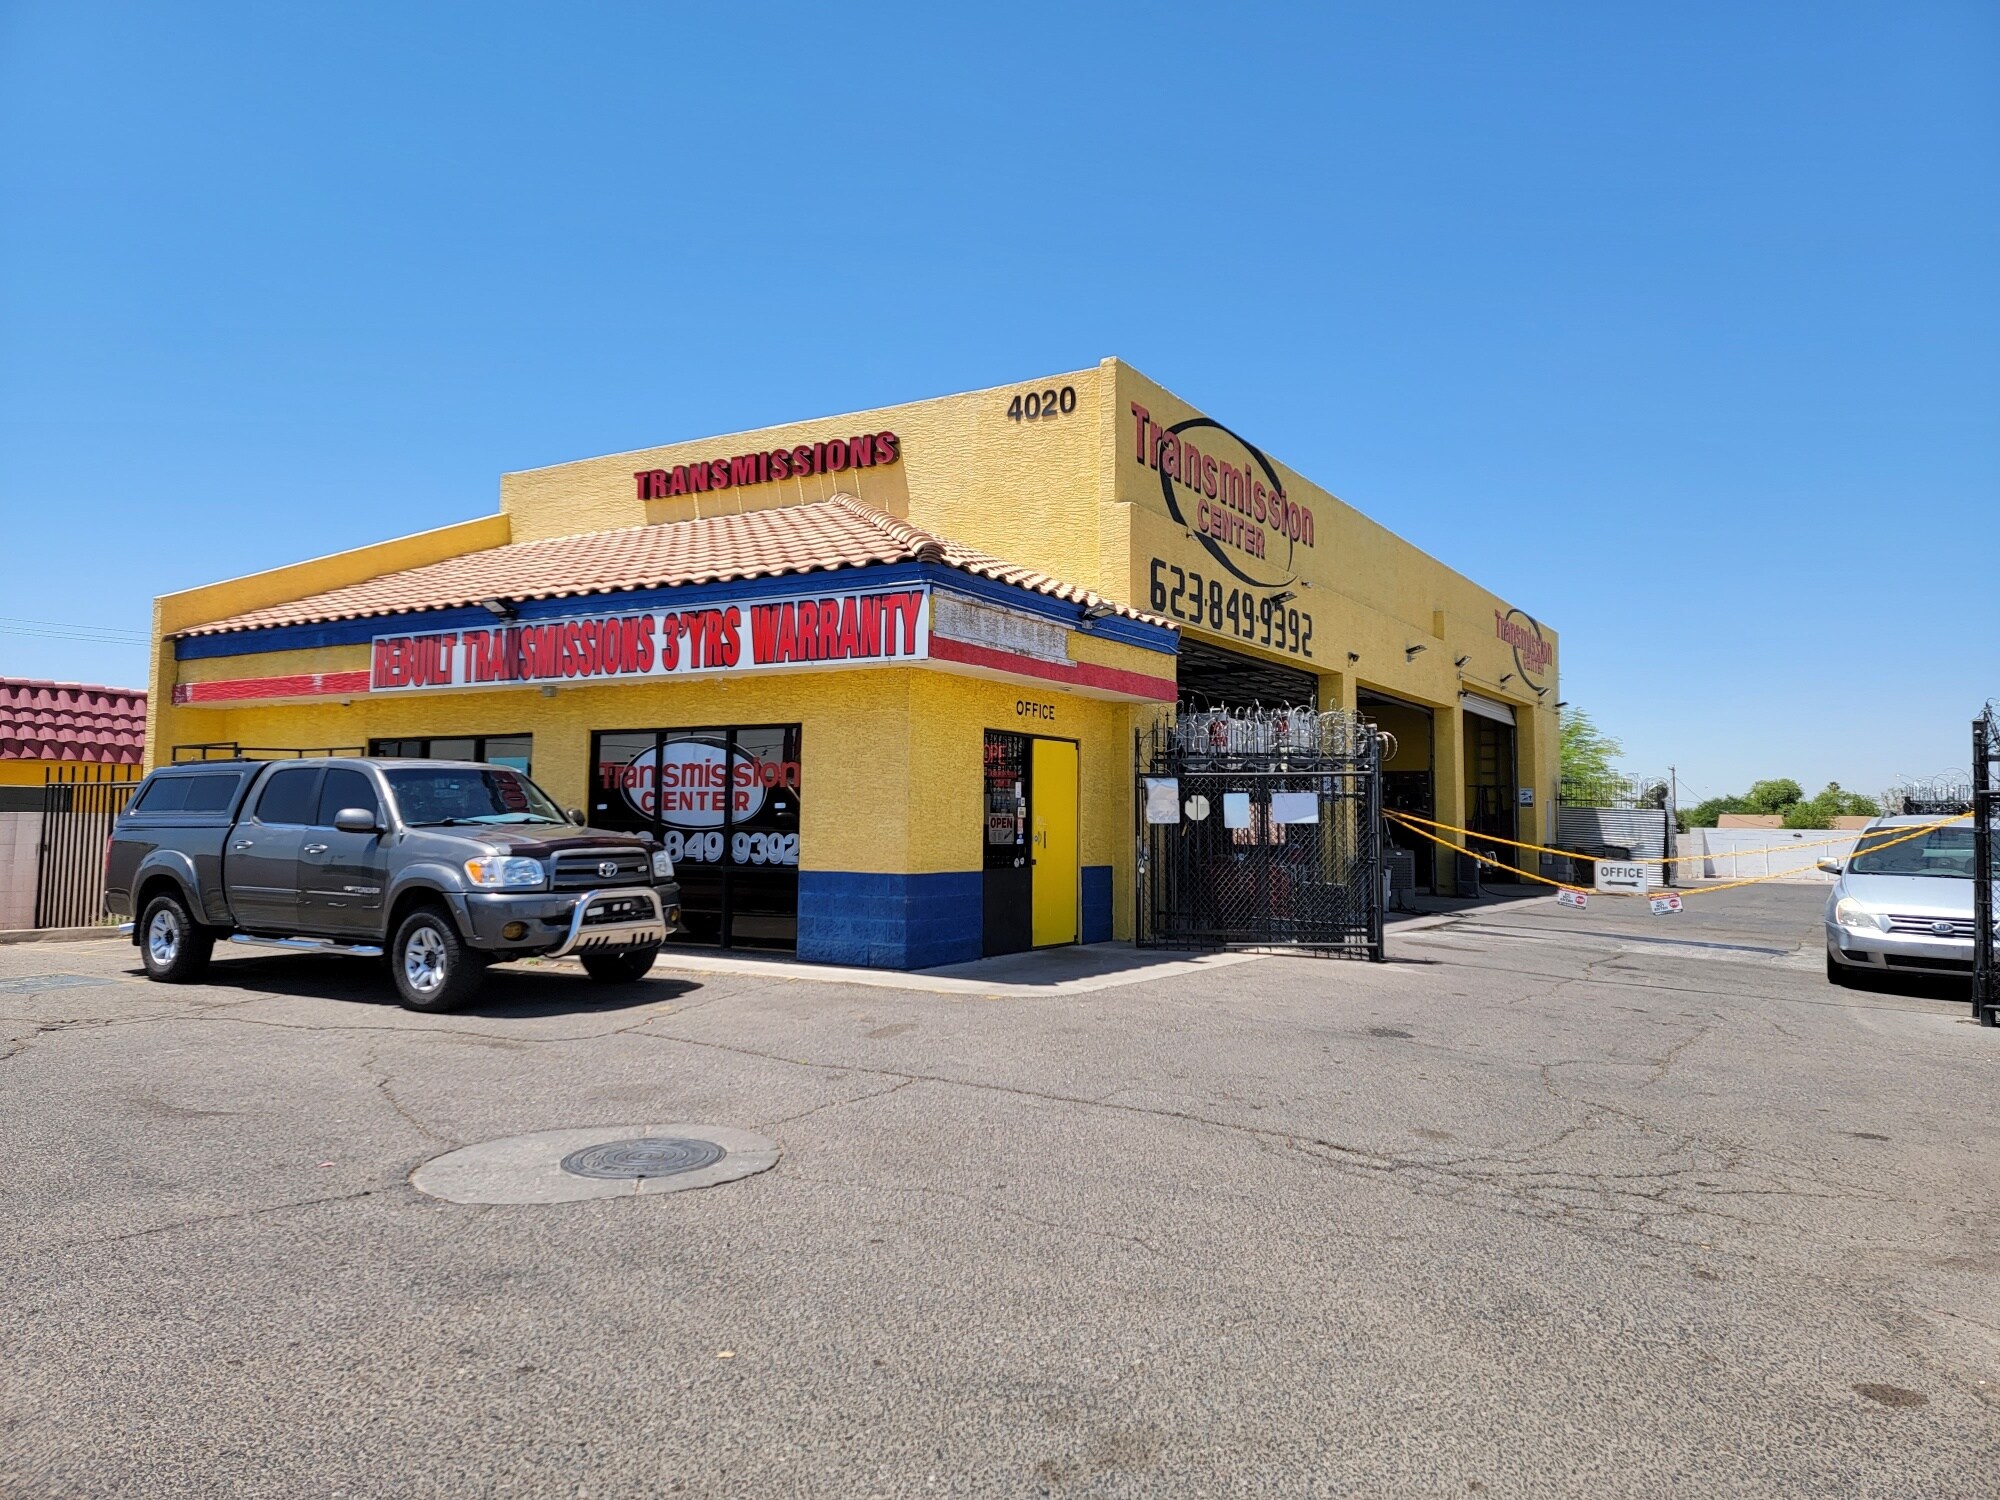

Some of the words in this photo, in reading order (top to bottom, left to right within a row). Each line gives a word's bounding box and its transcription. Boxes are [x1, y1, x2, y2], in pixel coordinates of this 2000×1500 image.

[1007, 386, 1077, 422] 4020
[634, 431, 902, 499] TRANSMISSIONS
[1131, 401, 1314, 547] Transmission
[1196, 499, 1266, 559] CENTER
[373, 632, 456, 688] REBUILT
[463, 614, 655, 684] TRANSMISSIONS
[750, 591, 924, 665] WARRANTY
[1016, 700, 1055, 720] OFFICE
[599, 758, 800, 789] Transmission
[641, 791, 750, 812] CENTER
[990, 817, 1013, 829] OPEN
[731, 832, 799, 865] 9392
[1600, 866, 1644, 879] OFFICE
